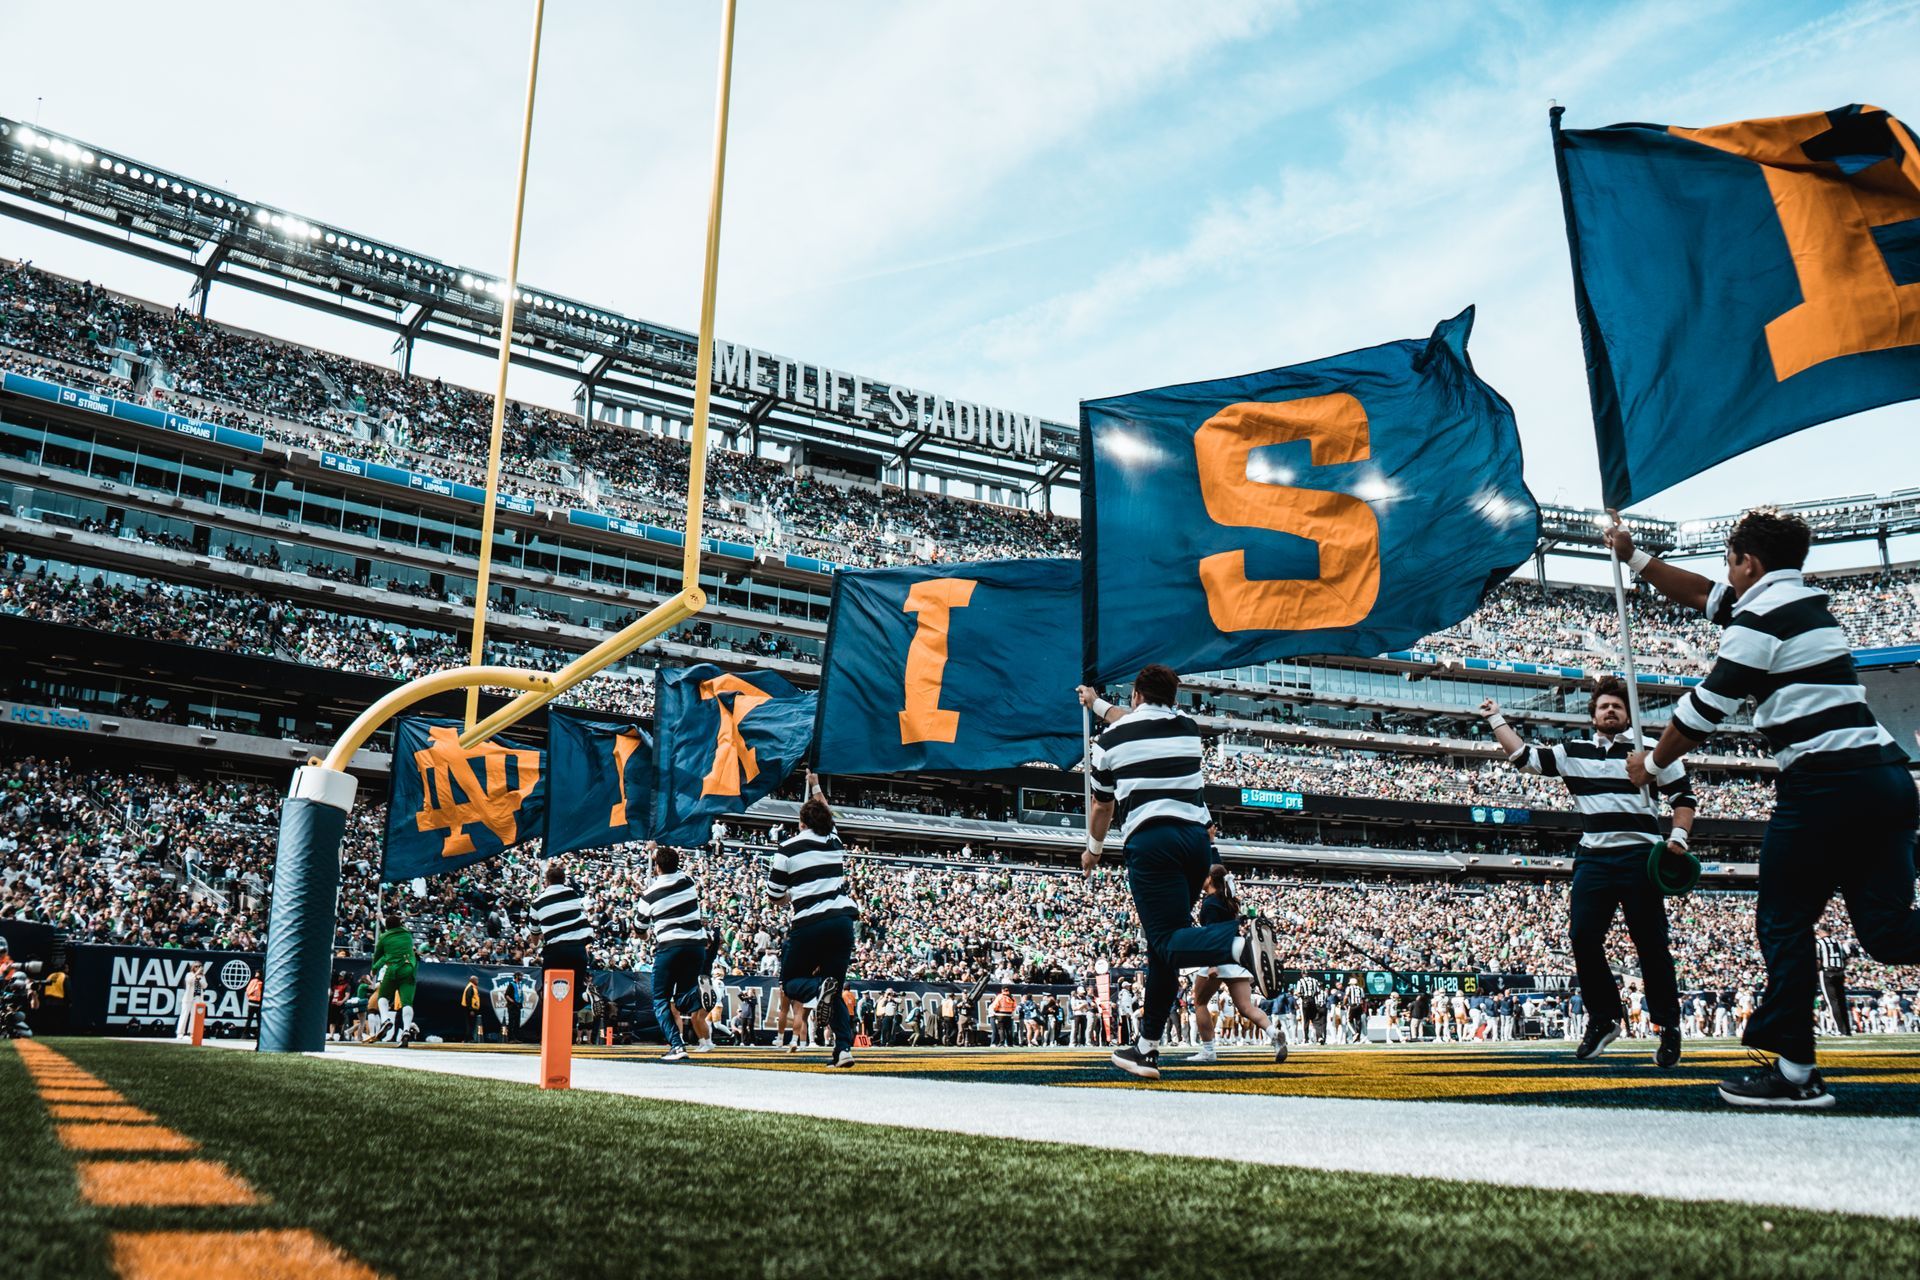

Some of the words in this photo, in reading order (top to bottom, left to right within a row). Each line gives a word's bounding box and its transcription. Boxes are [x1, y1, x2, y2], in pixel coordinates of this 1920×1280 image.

[63, 390, 76, 402] 50
[77, 398, 109, 413] STRONG
[713, 338, 875, 420] METLIFE
[888, 384, 1042, 457] STADIUM
[169, 417, 176, 427] 4
[177, 424, 211, 439] LEEMANS
[324, 455, 336, 467] 32
[338, 462, 361, 475] BLOZIS
[411, 475, 423, 486] 29
[1194, 392, 1381, 632] S
[898, 577, 978, 745] I
[1250, 789, 1283, 804] Game
[1285, 796, 1304, 809] pre
[1433, 976, 1459, 992] 10:28
[1464, 977, 1477, 993] 25
[1533, 975, 1572, 991] NAVY
